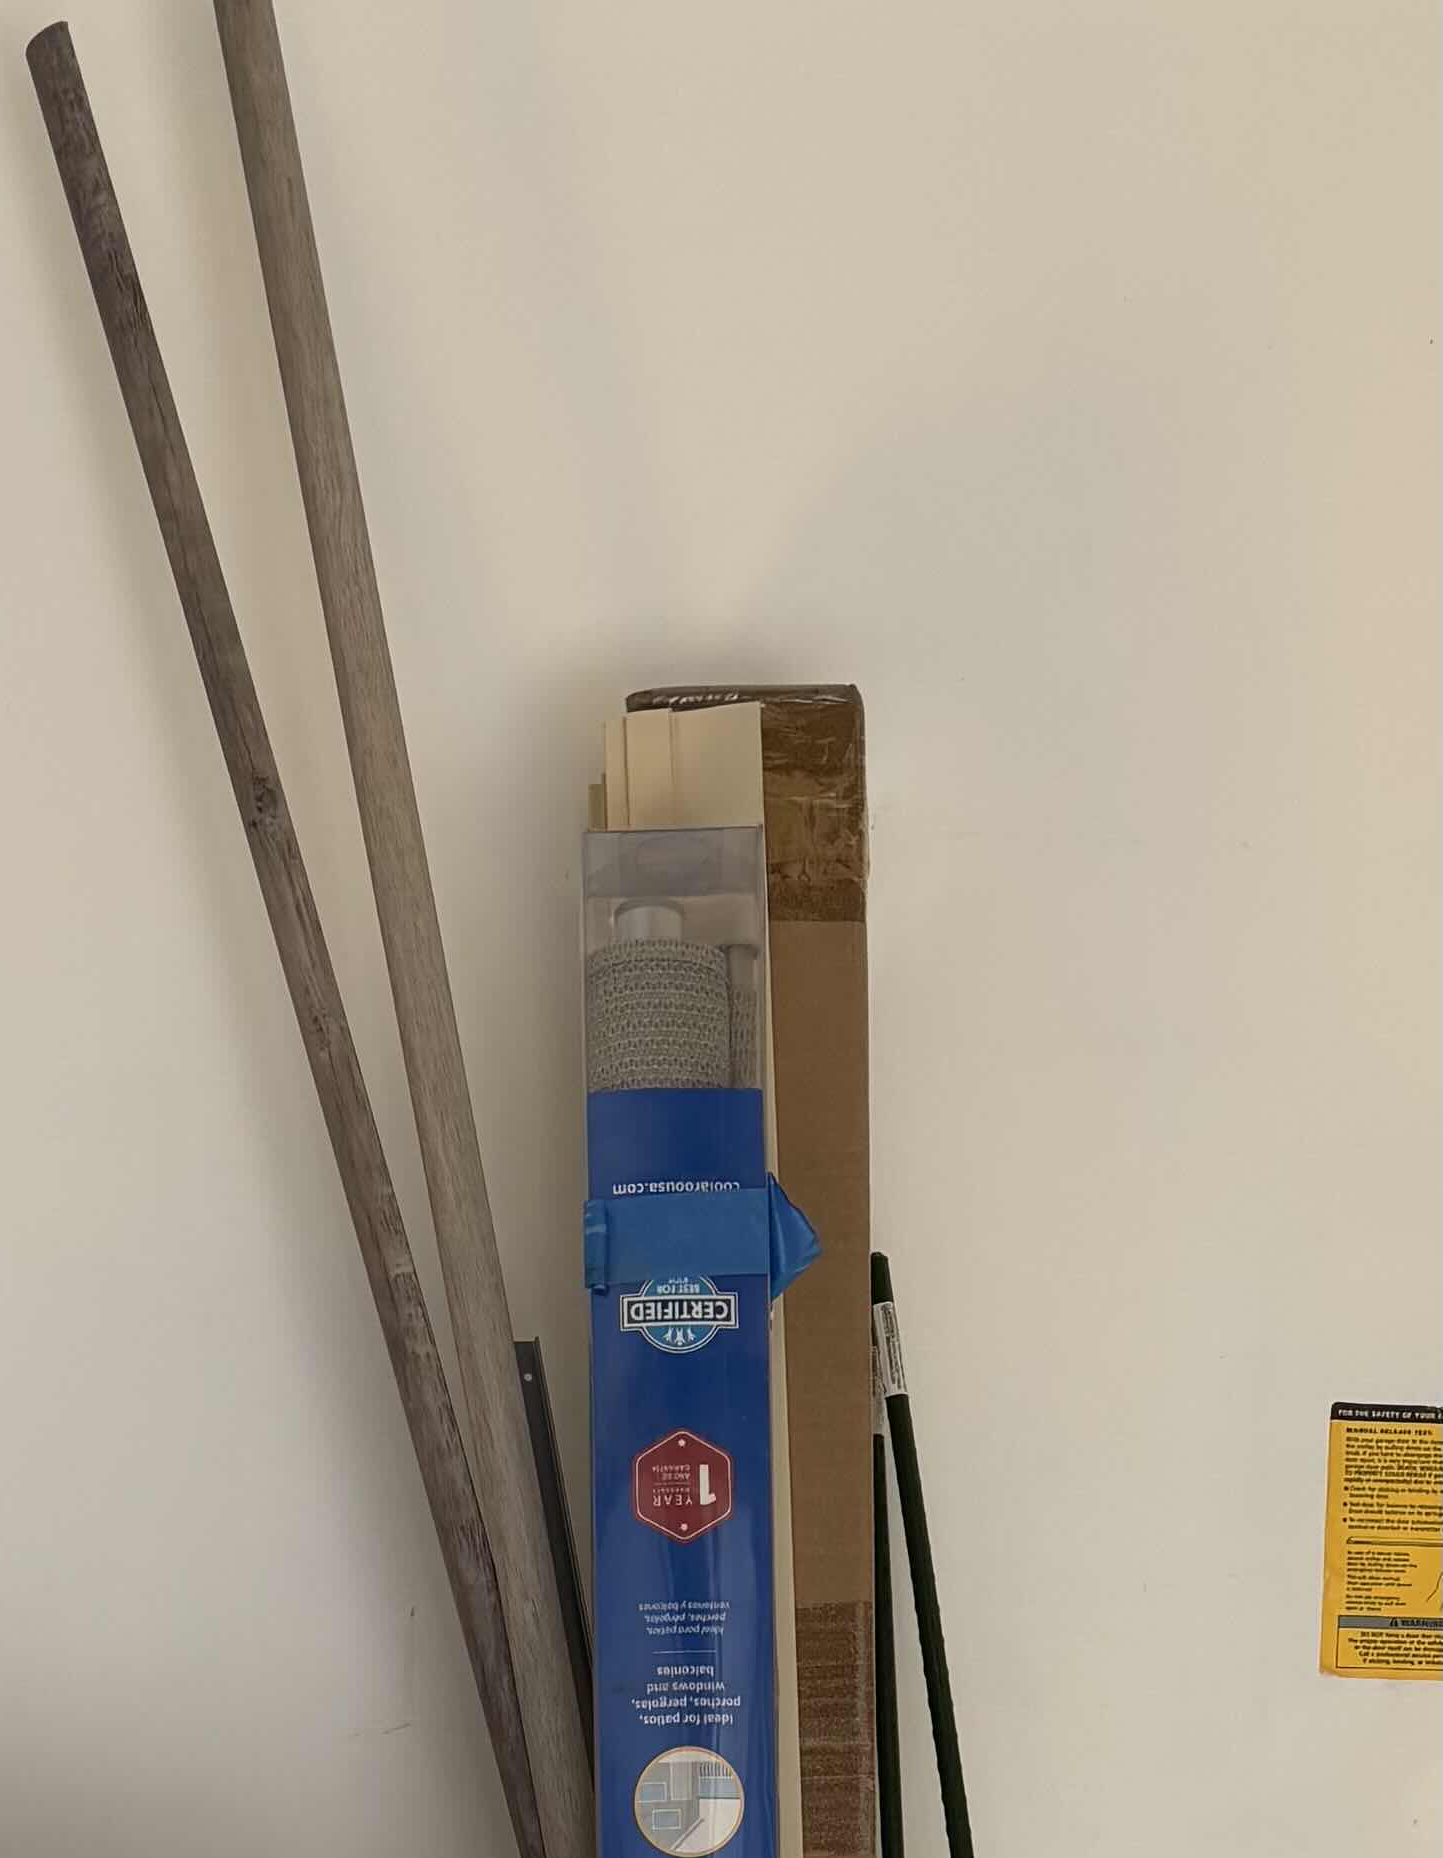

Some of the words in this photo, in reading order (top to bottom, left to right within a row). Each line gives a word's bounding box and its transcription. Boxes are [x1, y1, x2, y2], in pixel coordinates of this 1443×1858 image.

[629, 1300, 729, 1321] CERTIFIED
[698, 1464, 716, 1506] 1
[652, 1494, 693, 1506] YEAR
[657, 1665, 715, 1678] balconies
[672, 1681, 725, 1694] windows
[682, 1713, 701, 1726] for
